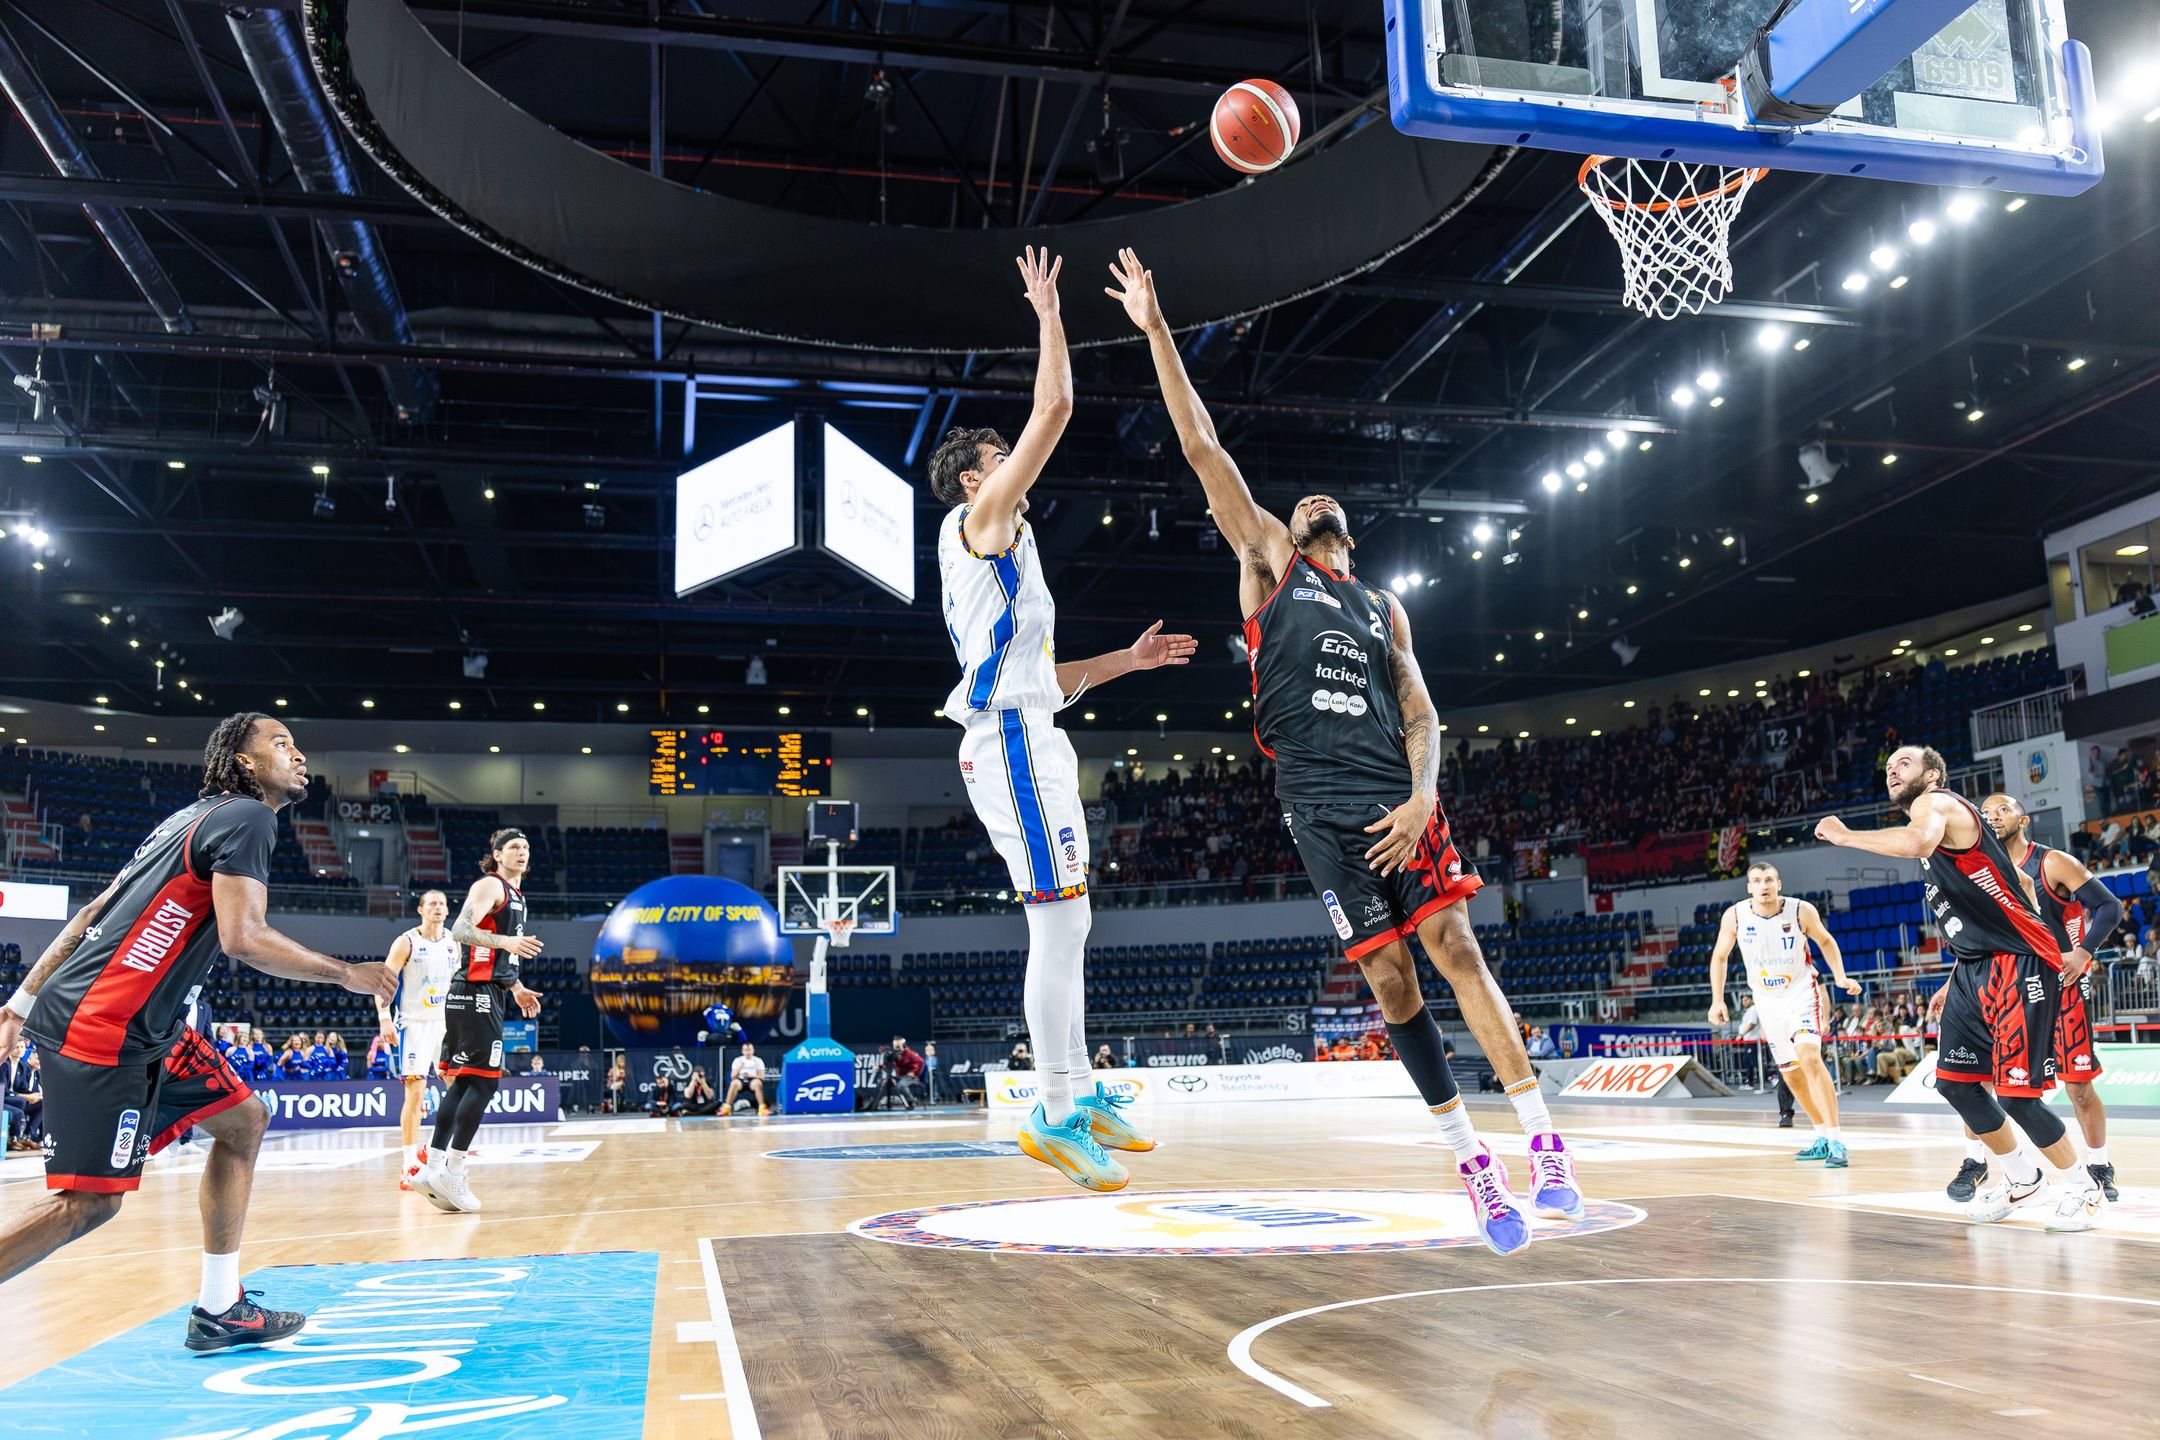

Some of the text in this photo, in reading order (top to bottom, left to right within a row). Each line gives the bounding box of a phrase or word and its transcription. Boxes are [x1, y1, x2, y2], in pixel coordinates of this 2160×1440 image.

[1296, 590, 1314, 598] PGE
[1321, 638, 1367, 664] Enea
[371, 804, 392, 820] P2
[666, 906, 702, 922] CITY
[704, 906, 724, 922] OF
[121, 898, 193, 972] ASTORIA
[1781, 936, 1795, 950] 17
[1763, 977, 1786, 987] LOTTO
[475, 993, 492, 1013] 1924
[1564, 1001, 1584, 1020] T1
[1287, 1013, 1306, 1031] S1
[810, 1047, 842, 1057] arriva
[1147, 1054, 1208, 1067] azzurro
[1217, 1073, 1262, 1082] Toyota
[1568, 1062, 1675, 1093] ANIRO
[484, 1083, 545, 1113] RUŃ
[795, 1087, 836, 1102] PGE
[1009, 1087, 1038, 1099] LOT
[279, 1087, 387, 1119] TORUŃ
[122, 1117, 138, 1125] PGE
[203, 1265, 541, 1395] arriva
